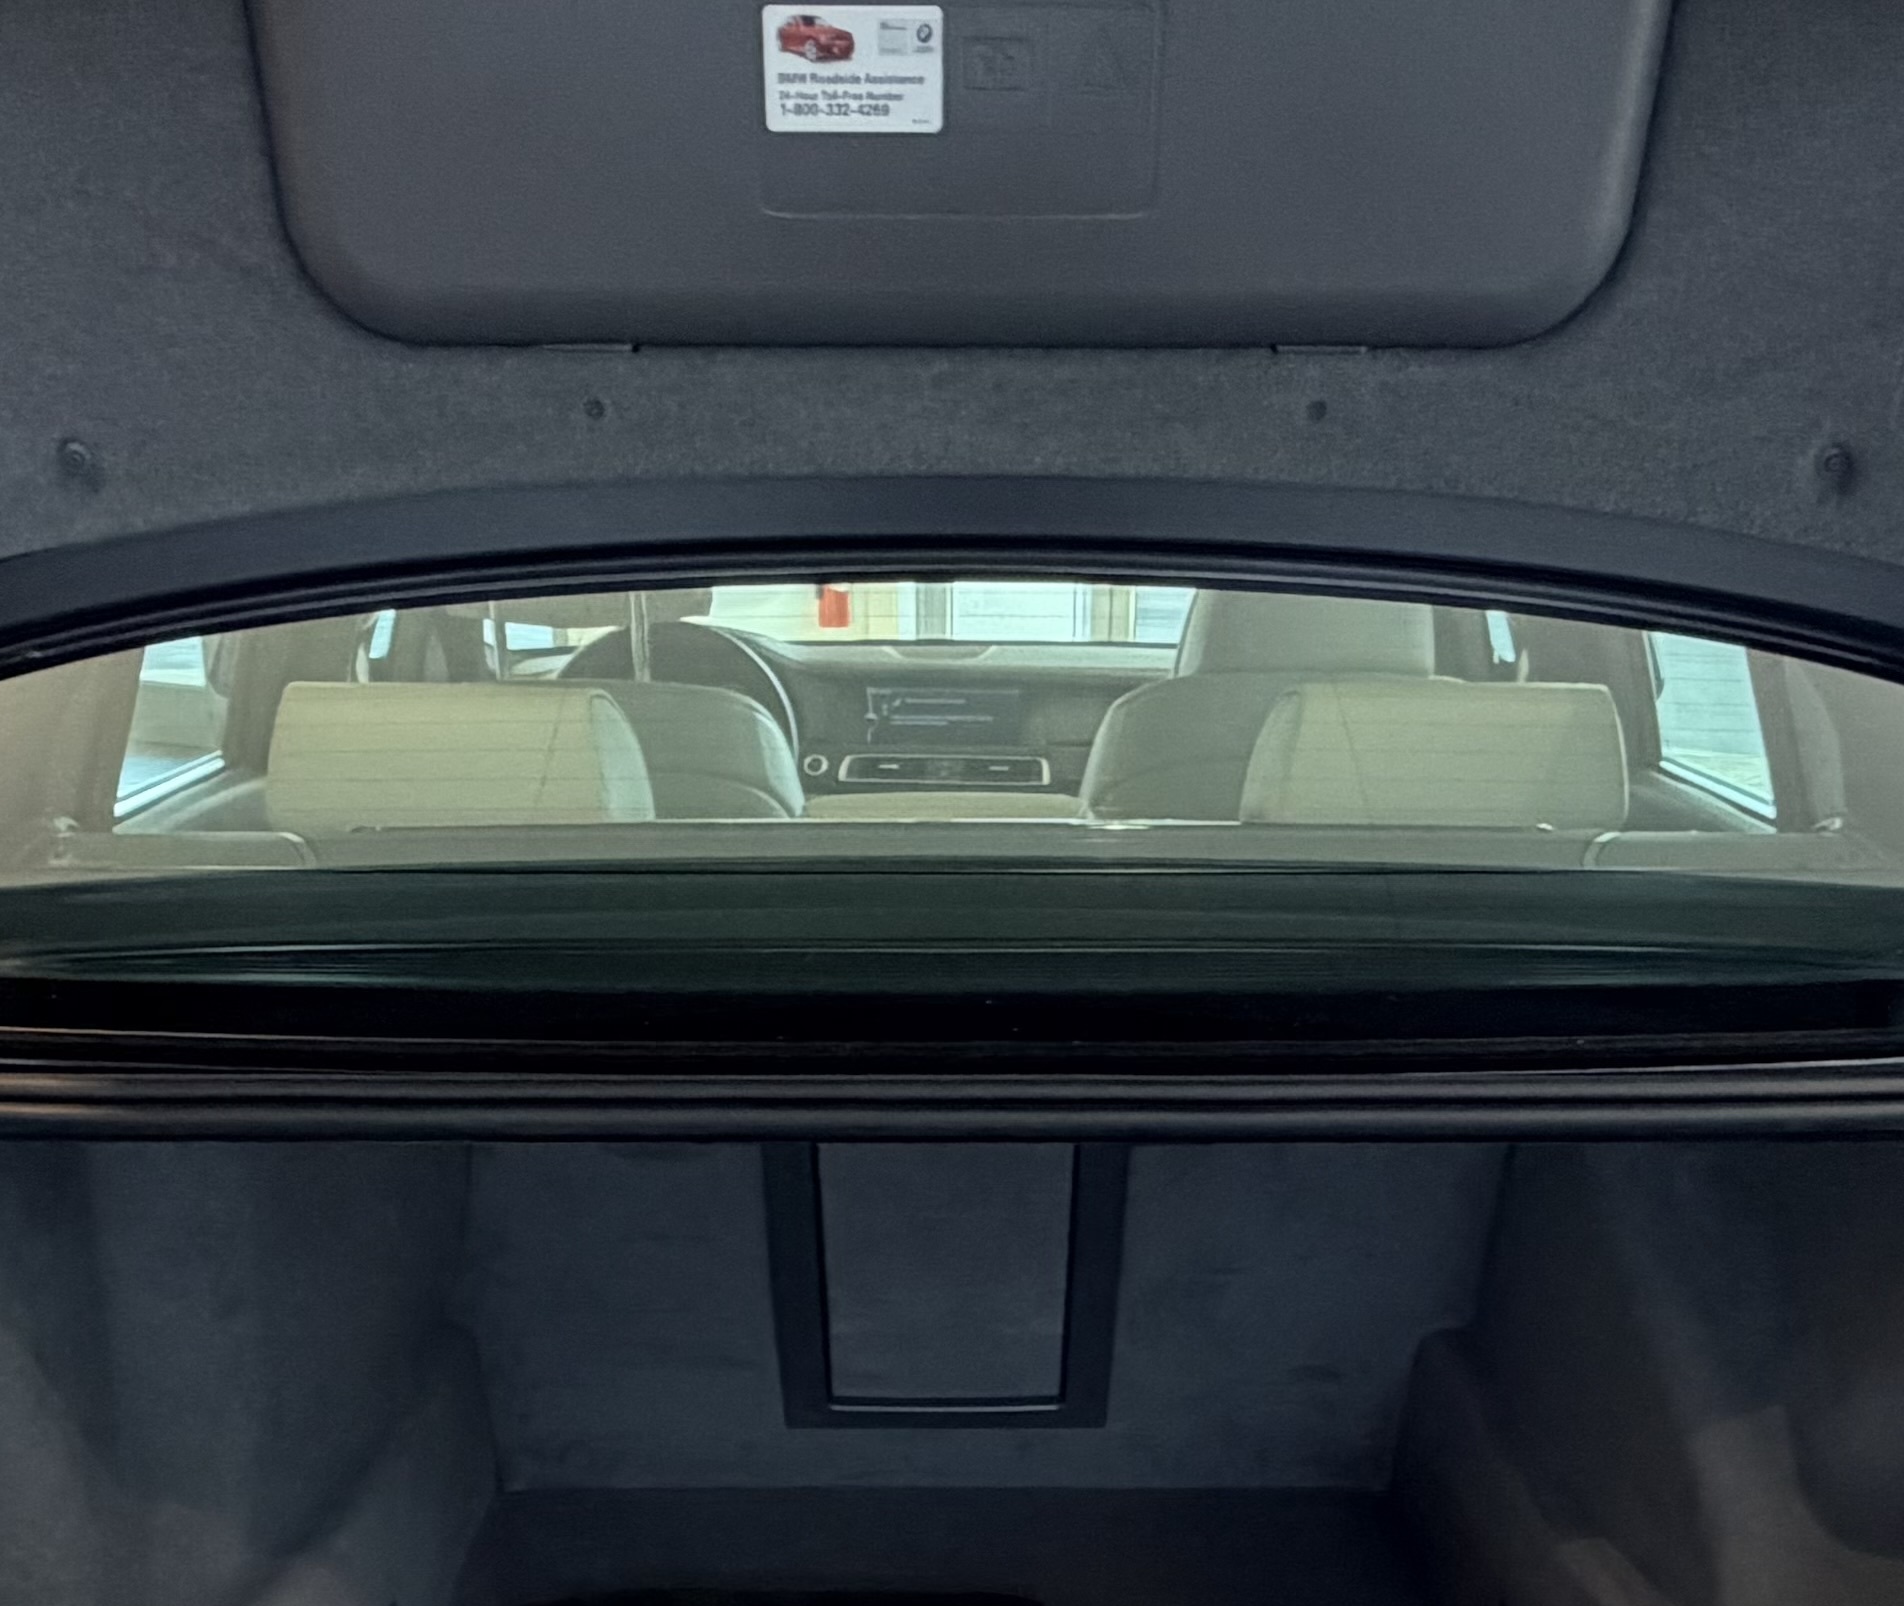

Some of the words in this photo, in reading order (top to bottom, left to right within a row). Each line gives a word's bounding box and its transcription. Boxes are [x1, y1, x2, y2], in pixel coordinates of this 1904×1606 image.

[778, 73, 807, 84] BMW
[809, 73, 862, 84] Roadside
[864, 73, 925, 85] Assistance
